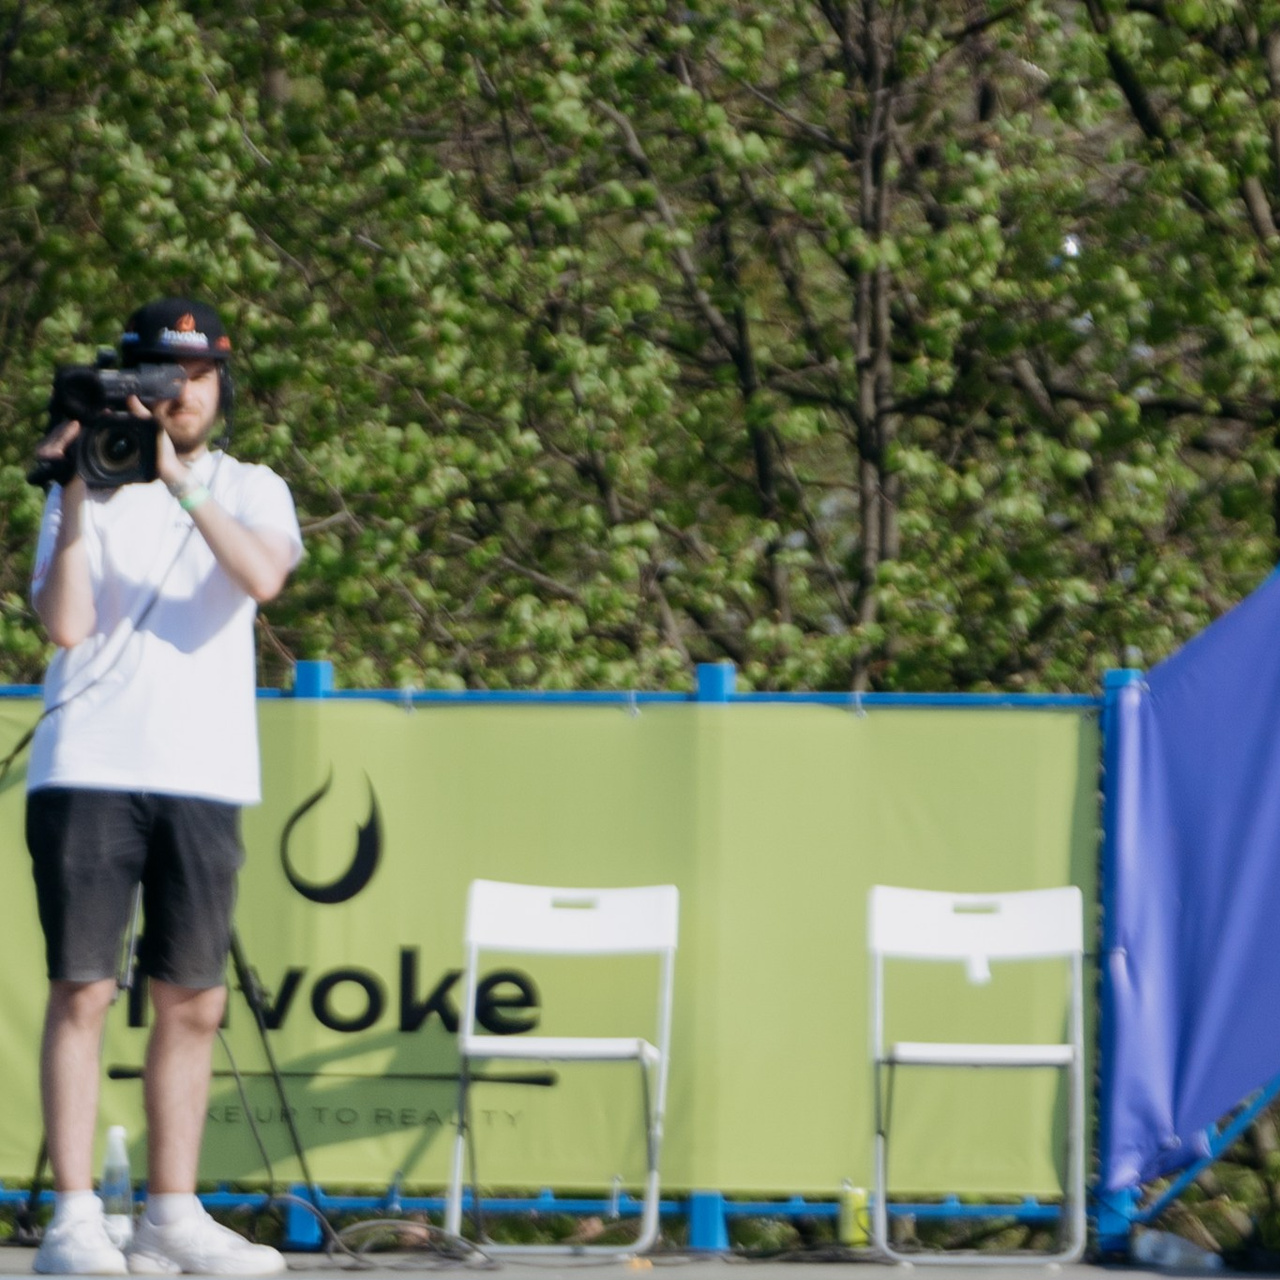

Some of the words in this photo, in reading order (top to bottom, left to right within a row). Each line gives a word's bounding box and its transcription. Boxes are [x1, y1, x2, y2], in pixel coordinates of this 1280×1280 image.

[128, 938, 542, 1035] ivoke
[312, 1106, 358, 1125] TO
[374, 1106, 525, 1128] REALTY
